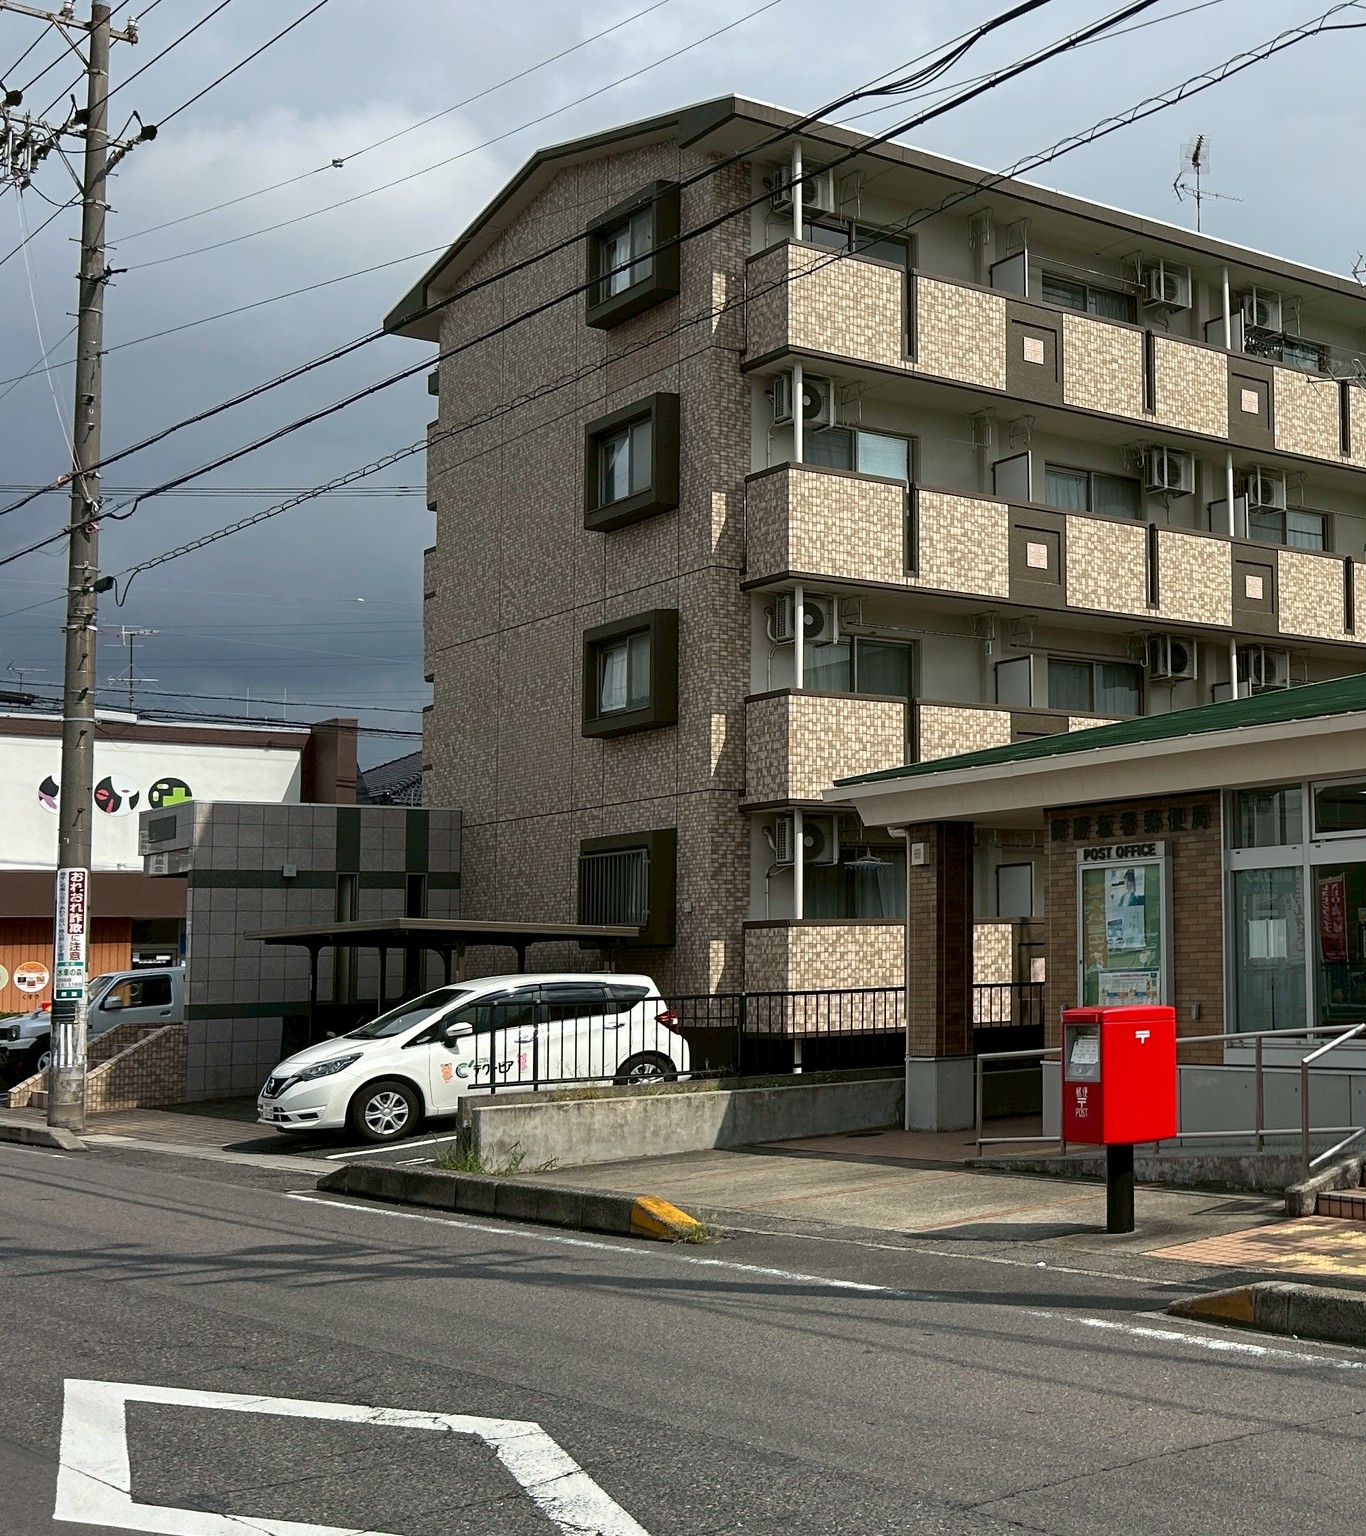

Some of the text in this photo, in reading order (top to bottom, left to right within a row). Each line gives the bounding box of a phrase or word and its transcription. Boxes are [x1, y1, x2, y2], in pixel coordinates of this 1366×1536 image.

[1083, 843, 1157, 861] POST OFFICE
[1076, 1108, 1089, 1117] POST
